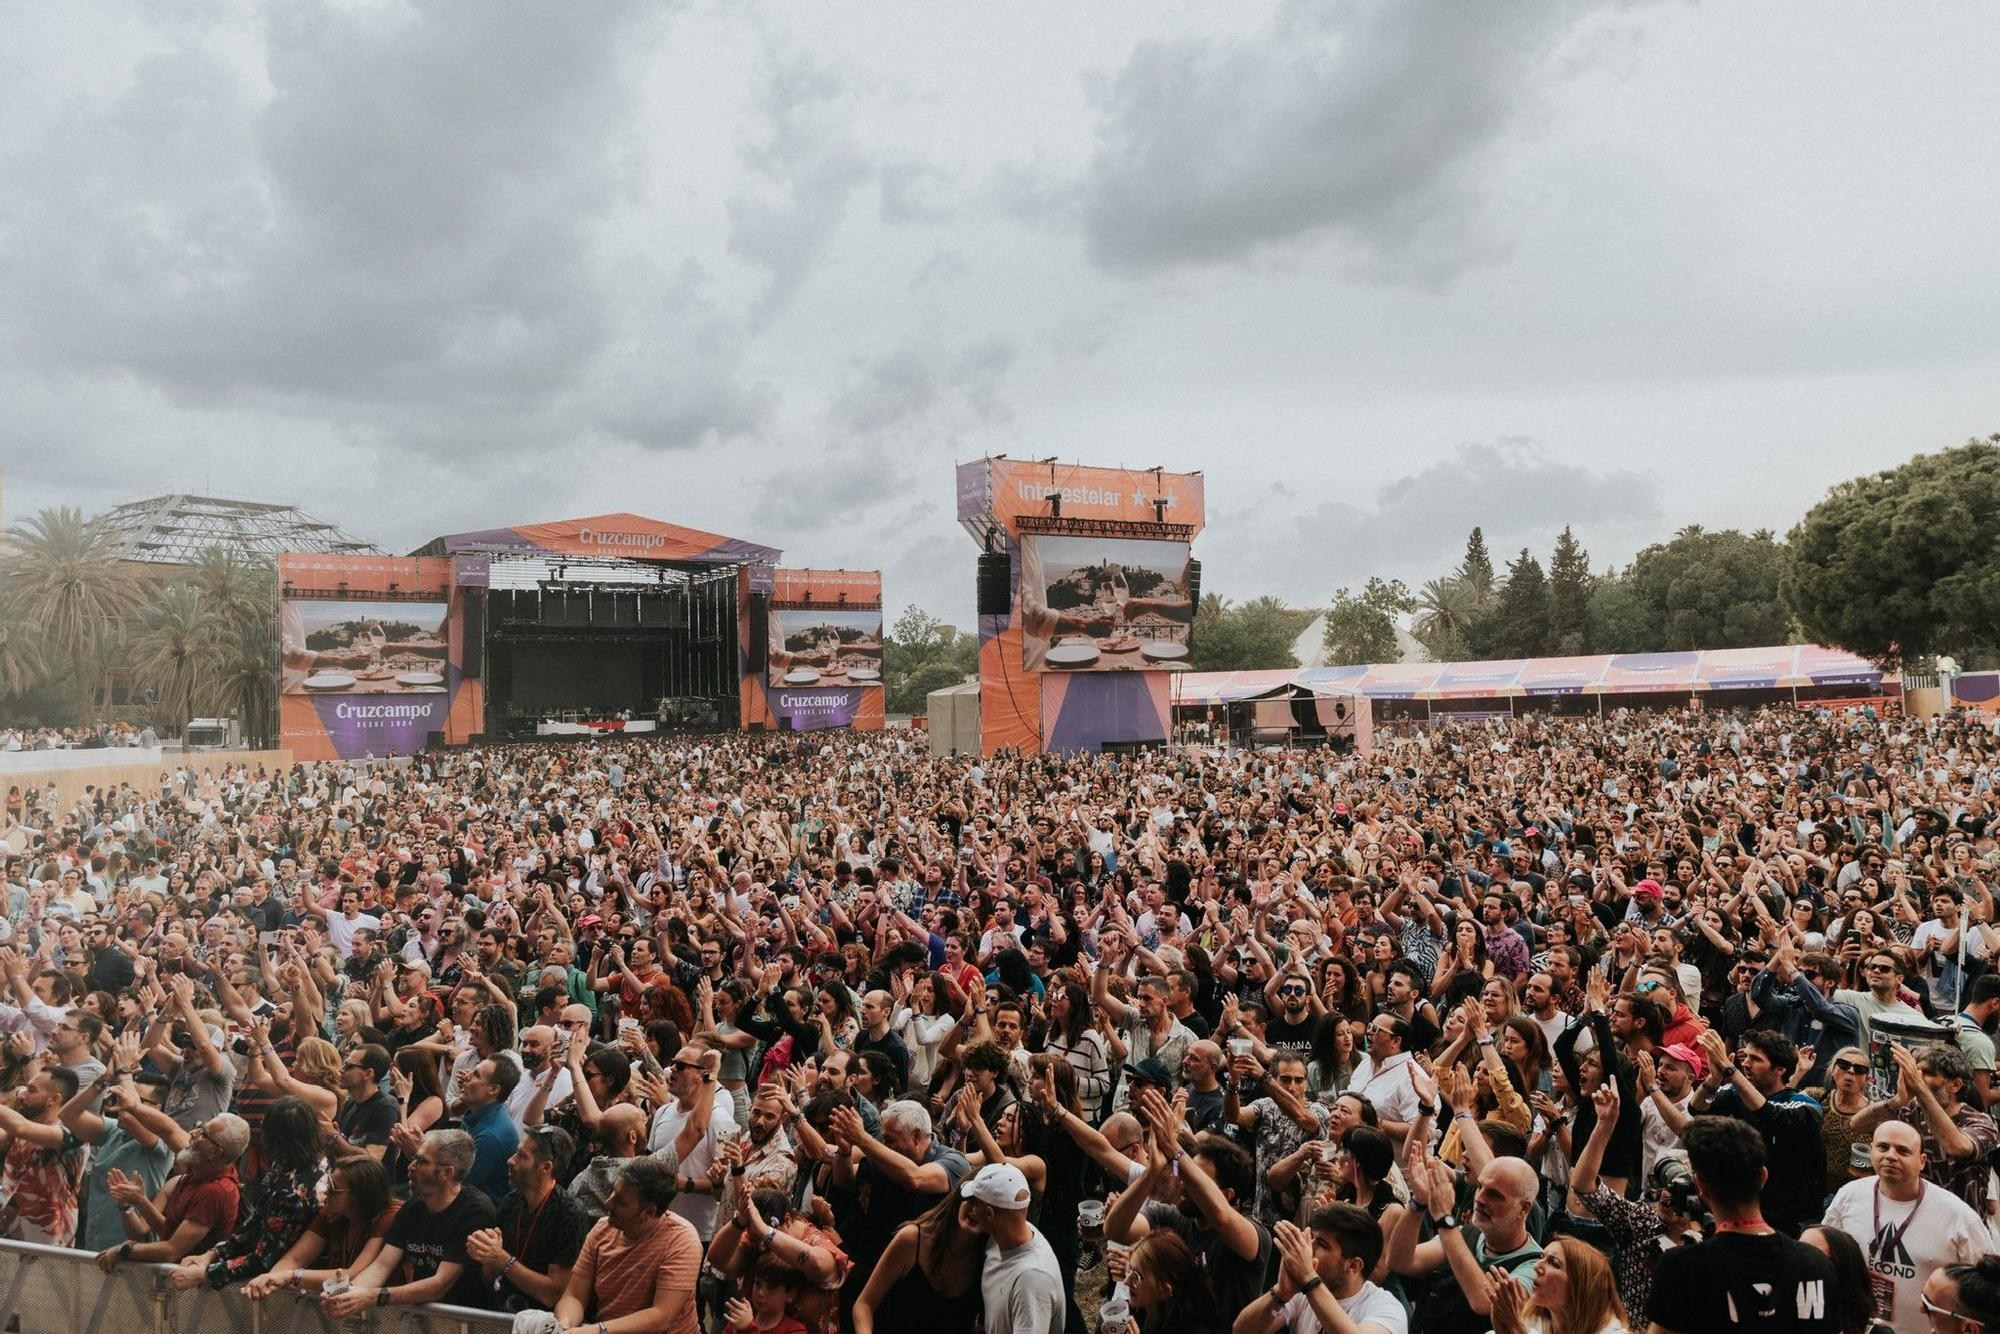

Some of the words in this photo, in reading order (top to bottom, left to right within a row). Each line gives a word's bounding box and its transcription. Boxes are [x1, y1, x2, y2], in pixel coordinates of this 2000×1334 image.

[579, 527, 667, 549] Cruzcampo
[780, 694, 848, 708] Cruzcampo
[336, 702, 432, 719] Cruzcampo
[1868, 1259, 1915, 1279] ECOND
